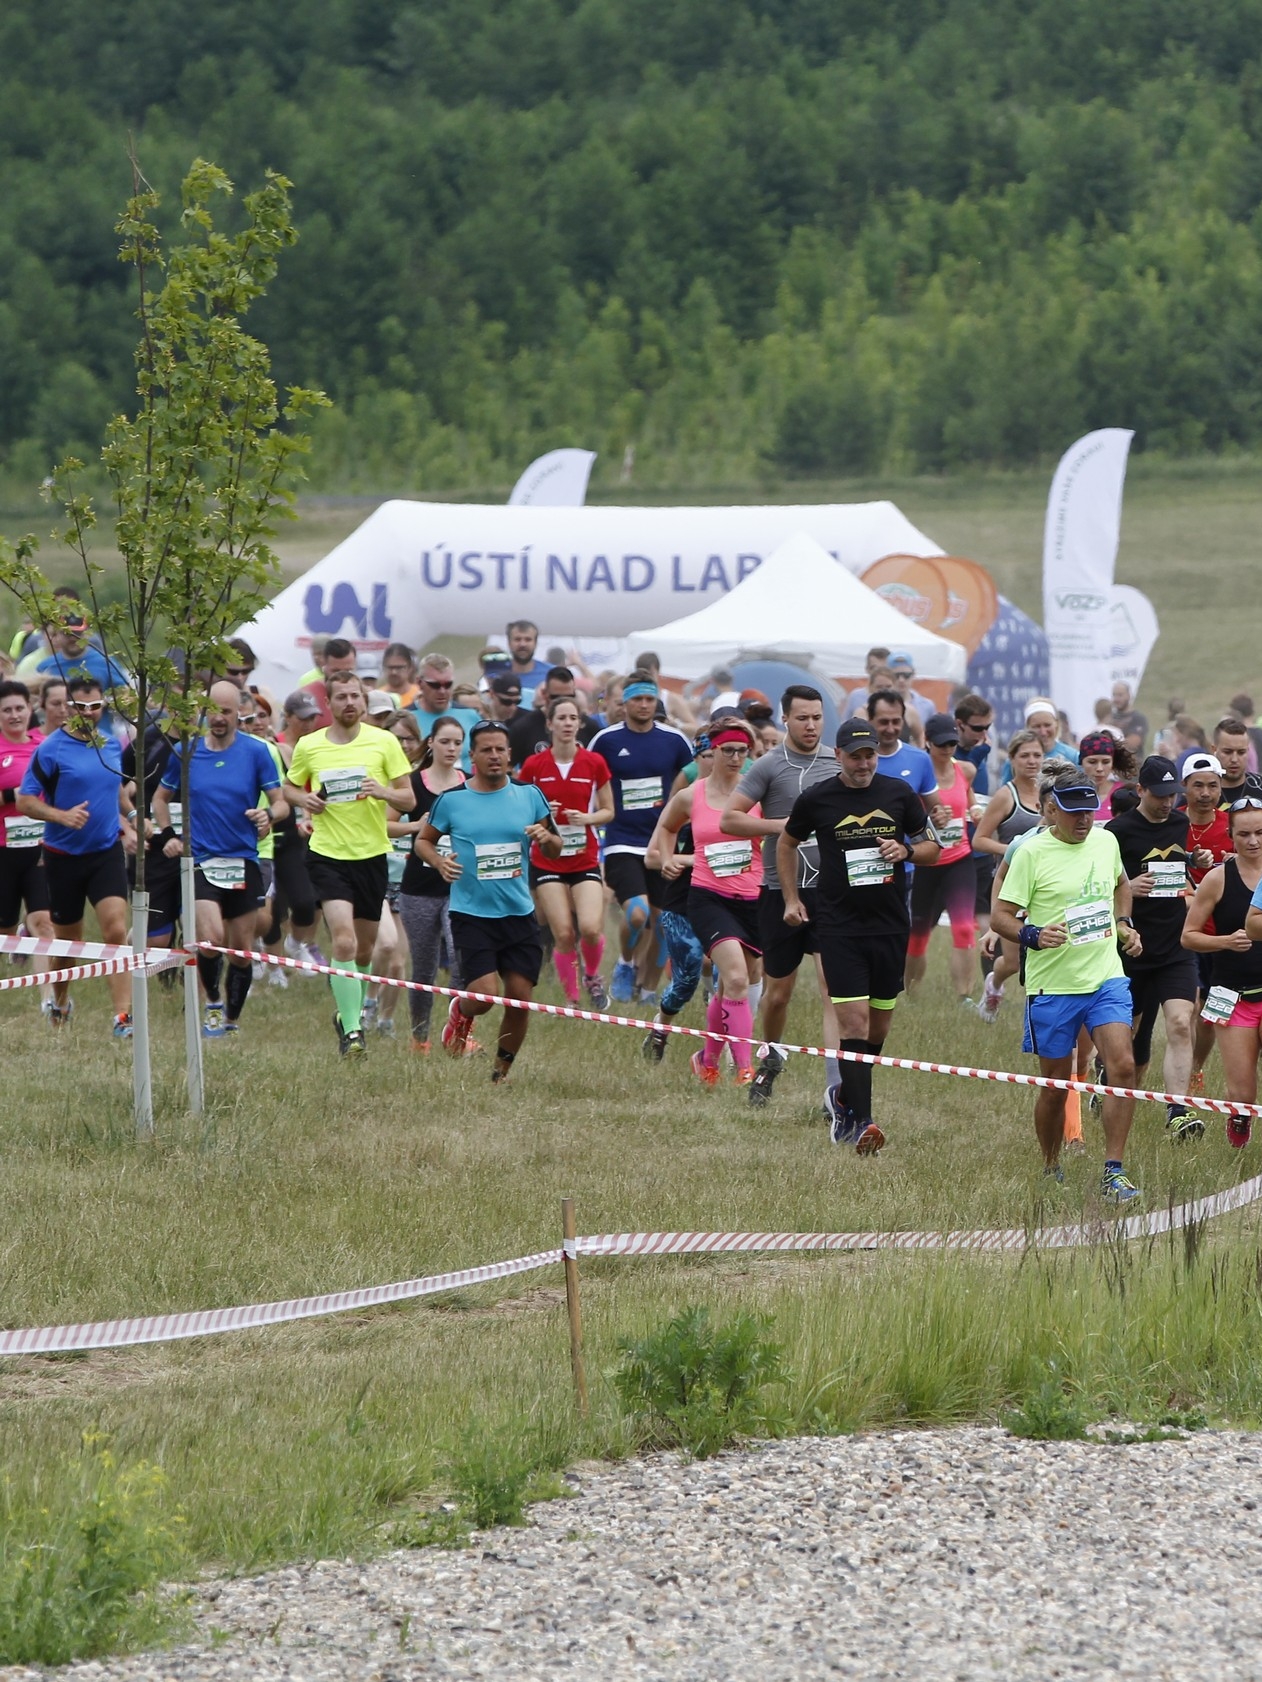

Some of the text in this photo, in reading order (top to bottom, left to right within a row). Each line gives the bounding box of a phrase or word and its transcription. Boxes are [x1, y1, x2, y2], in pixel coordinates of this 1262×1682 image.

[421, 543, 532, 591] ÚSTÍ
[546, 554, 656, 592] NAD
[487, 856, 514, 867] 416
[715, 854, 743, 866] 289
[857, 862, 885, 873] 272
[1080, 917, 1105, 930] 446
